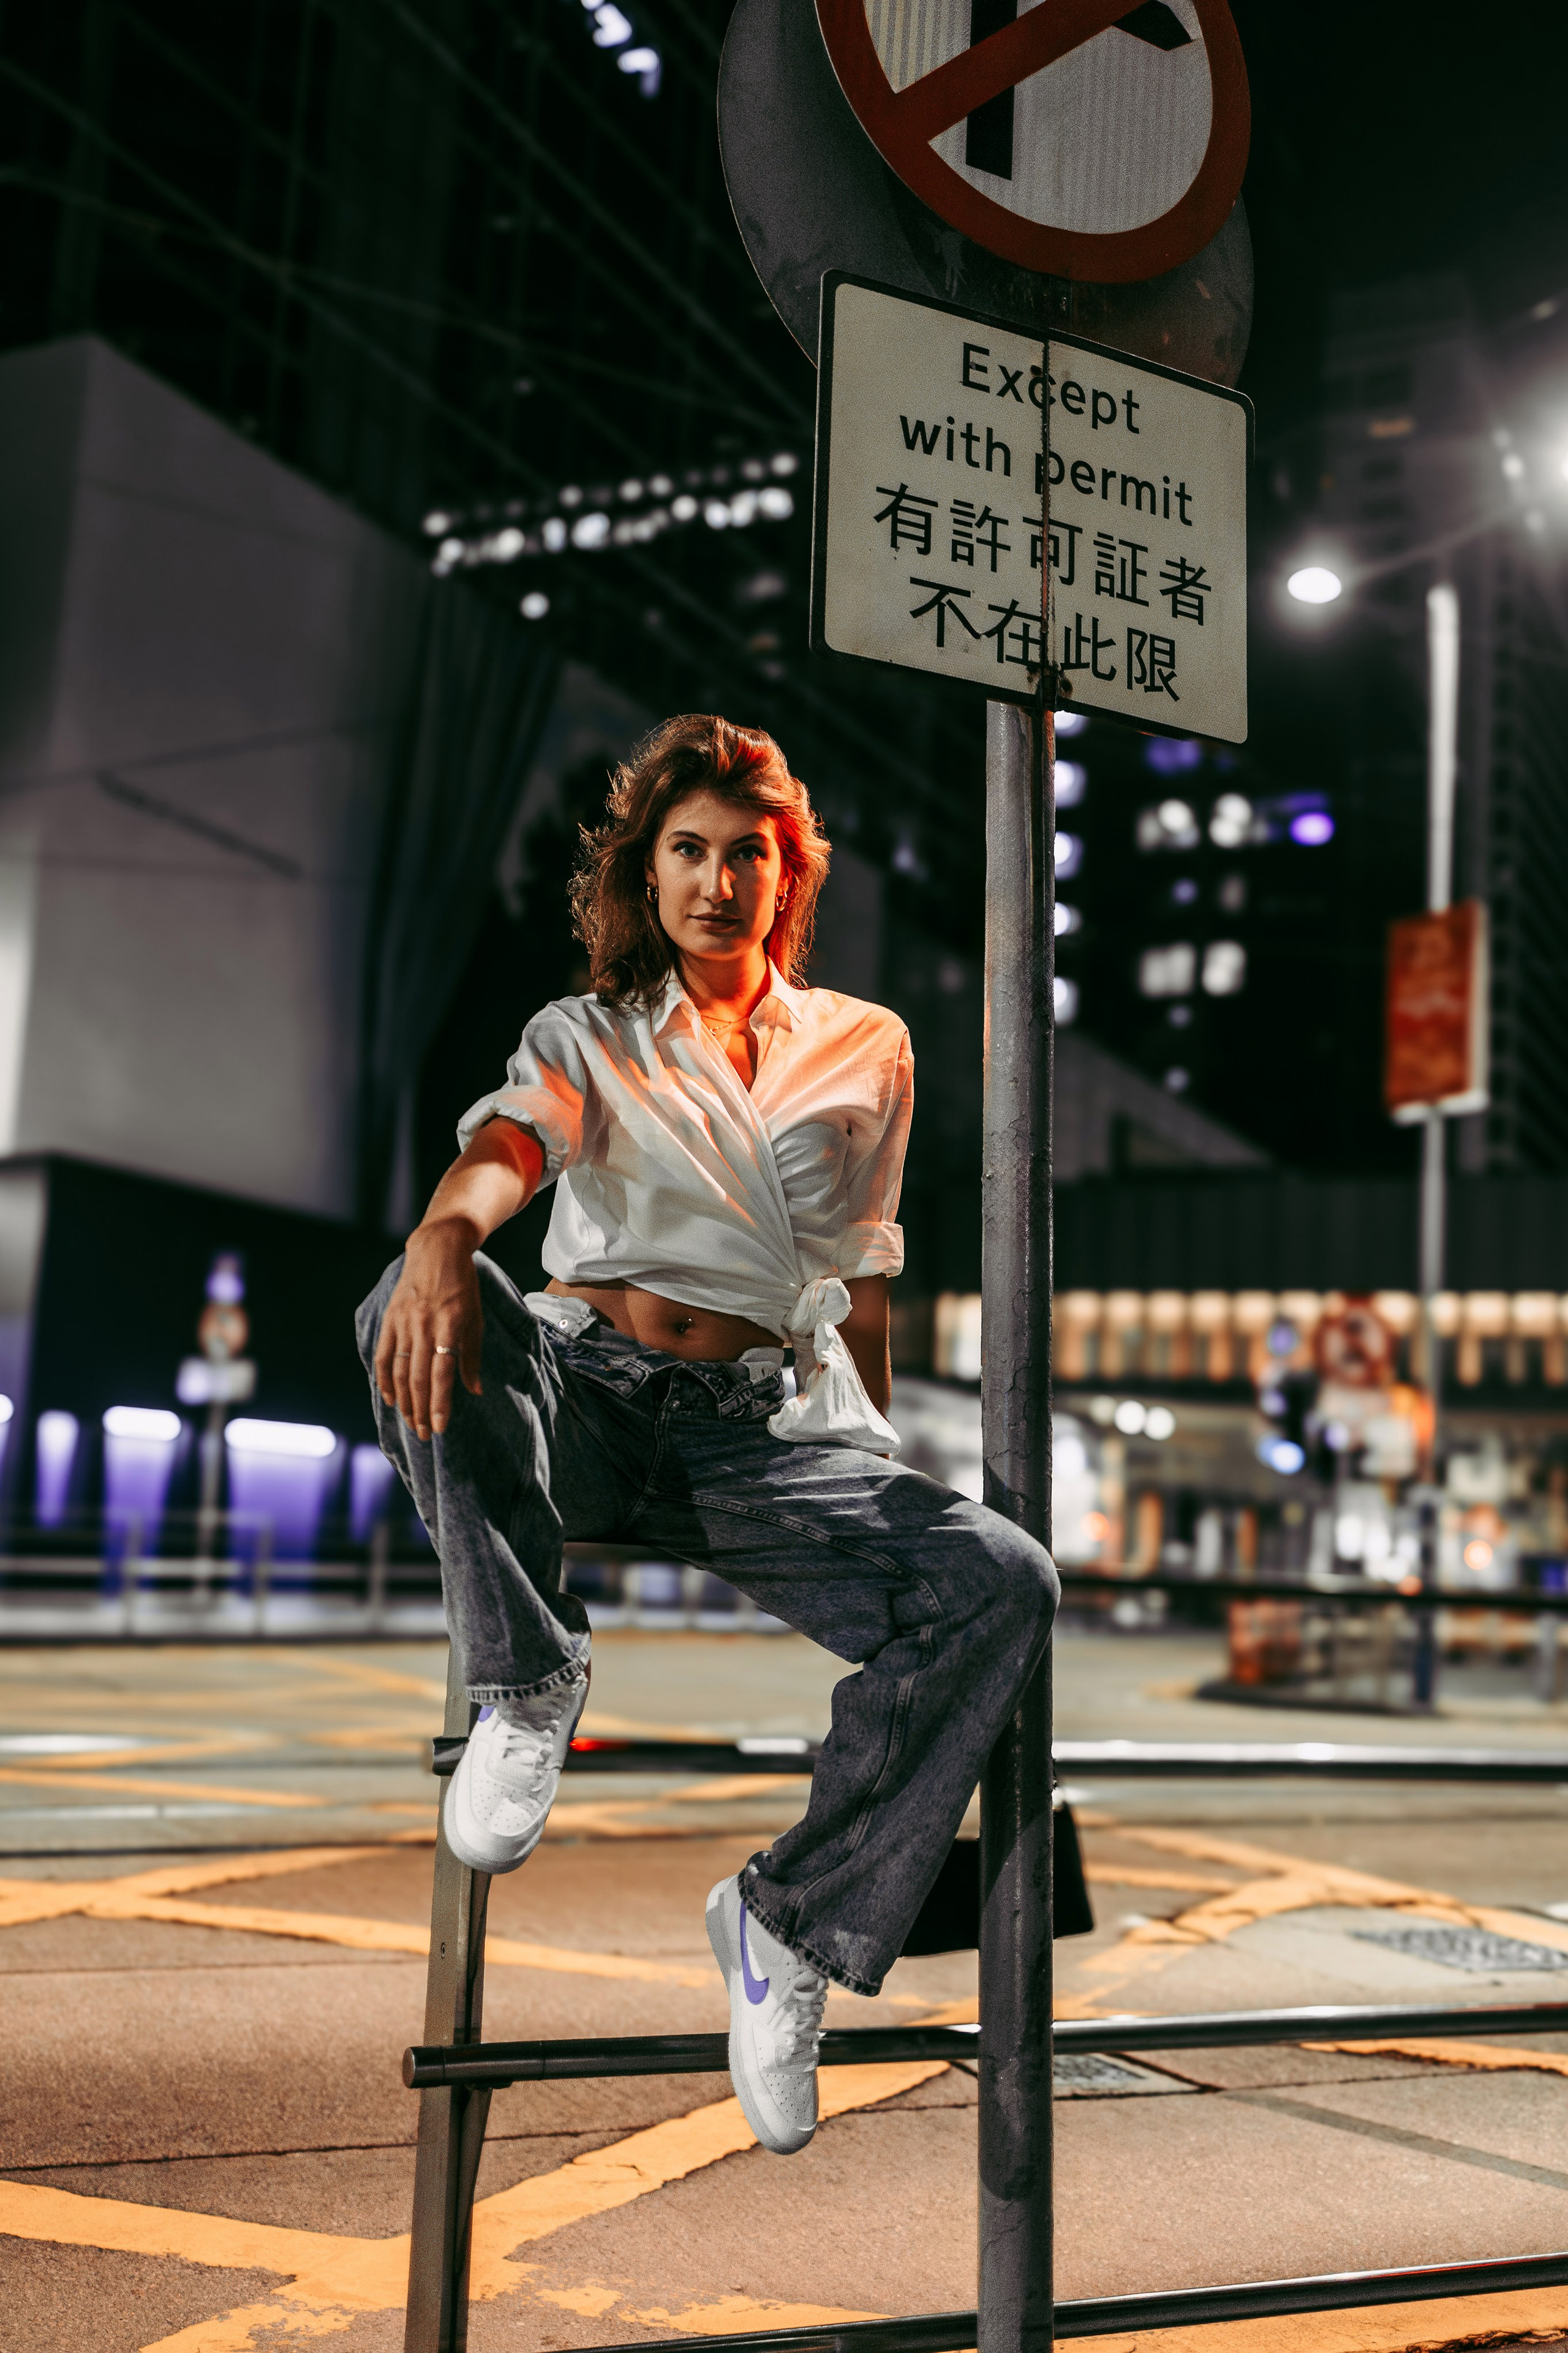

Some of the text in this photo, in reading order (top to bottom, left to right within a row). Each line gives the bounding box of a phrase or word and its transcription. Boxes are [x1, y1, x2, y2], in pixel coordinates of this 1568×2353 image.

[962, 342, 1140, 434] Except
[900, 415, 1193, 527] with permit
[874, 483, 1212, 626] 有許可証者
[909, 577, 1180, 701] 不在此限
